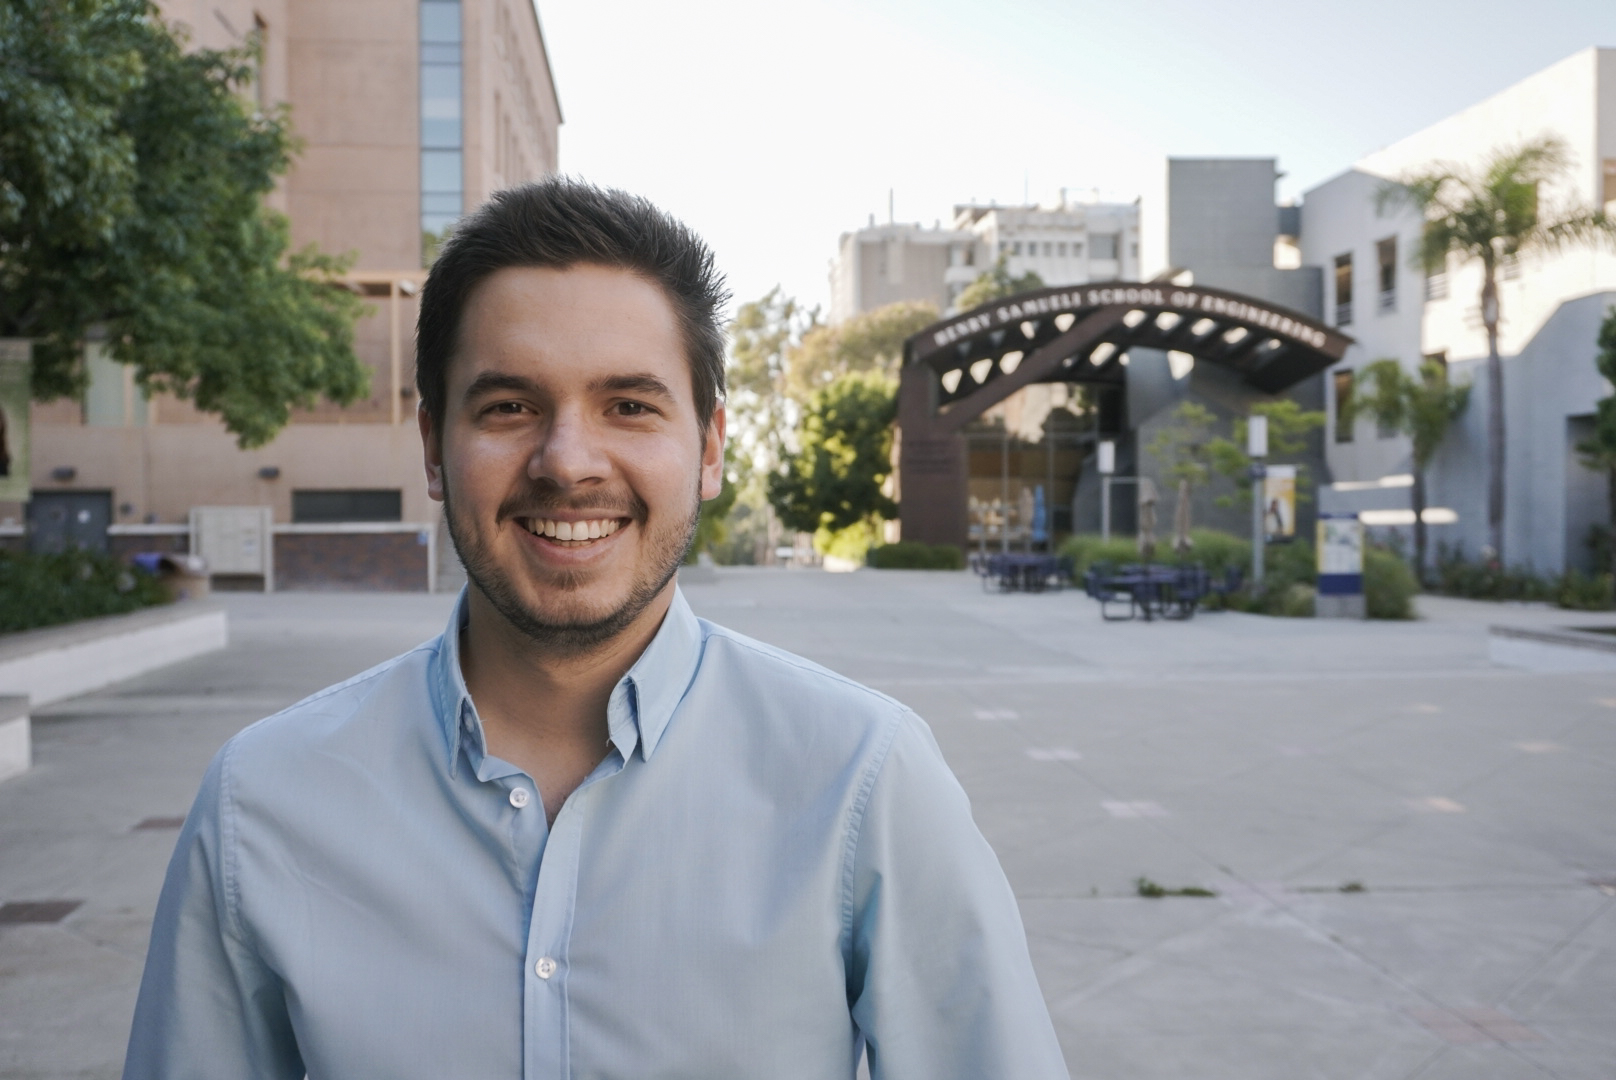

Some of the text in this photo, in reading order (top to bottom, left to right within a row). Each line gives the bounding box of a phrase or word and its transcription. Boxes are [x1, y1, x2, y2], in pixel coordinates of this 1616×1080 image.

[934, 288, 1327, 348] HENRY SAMUELI SCHOOL OF ENGINEERING
